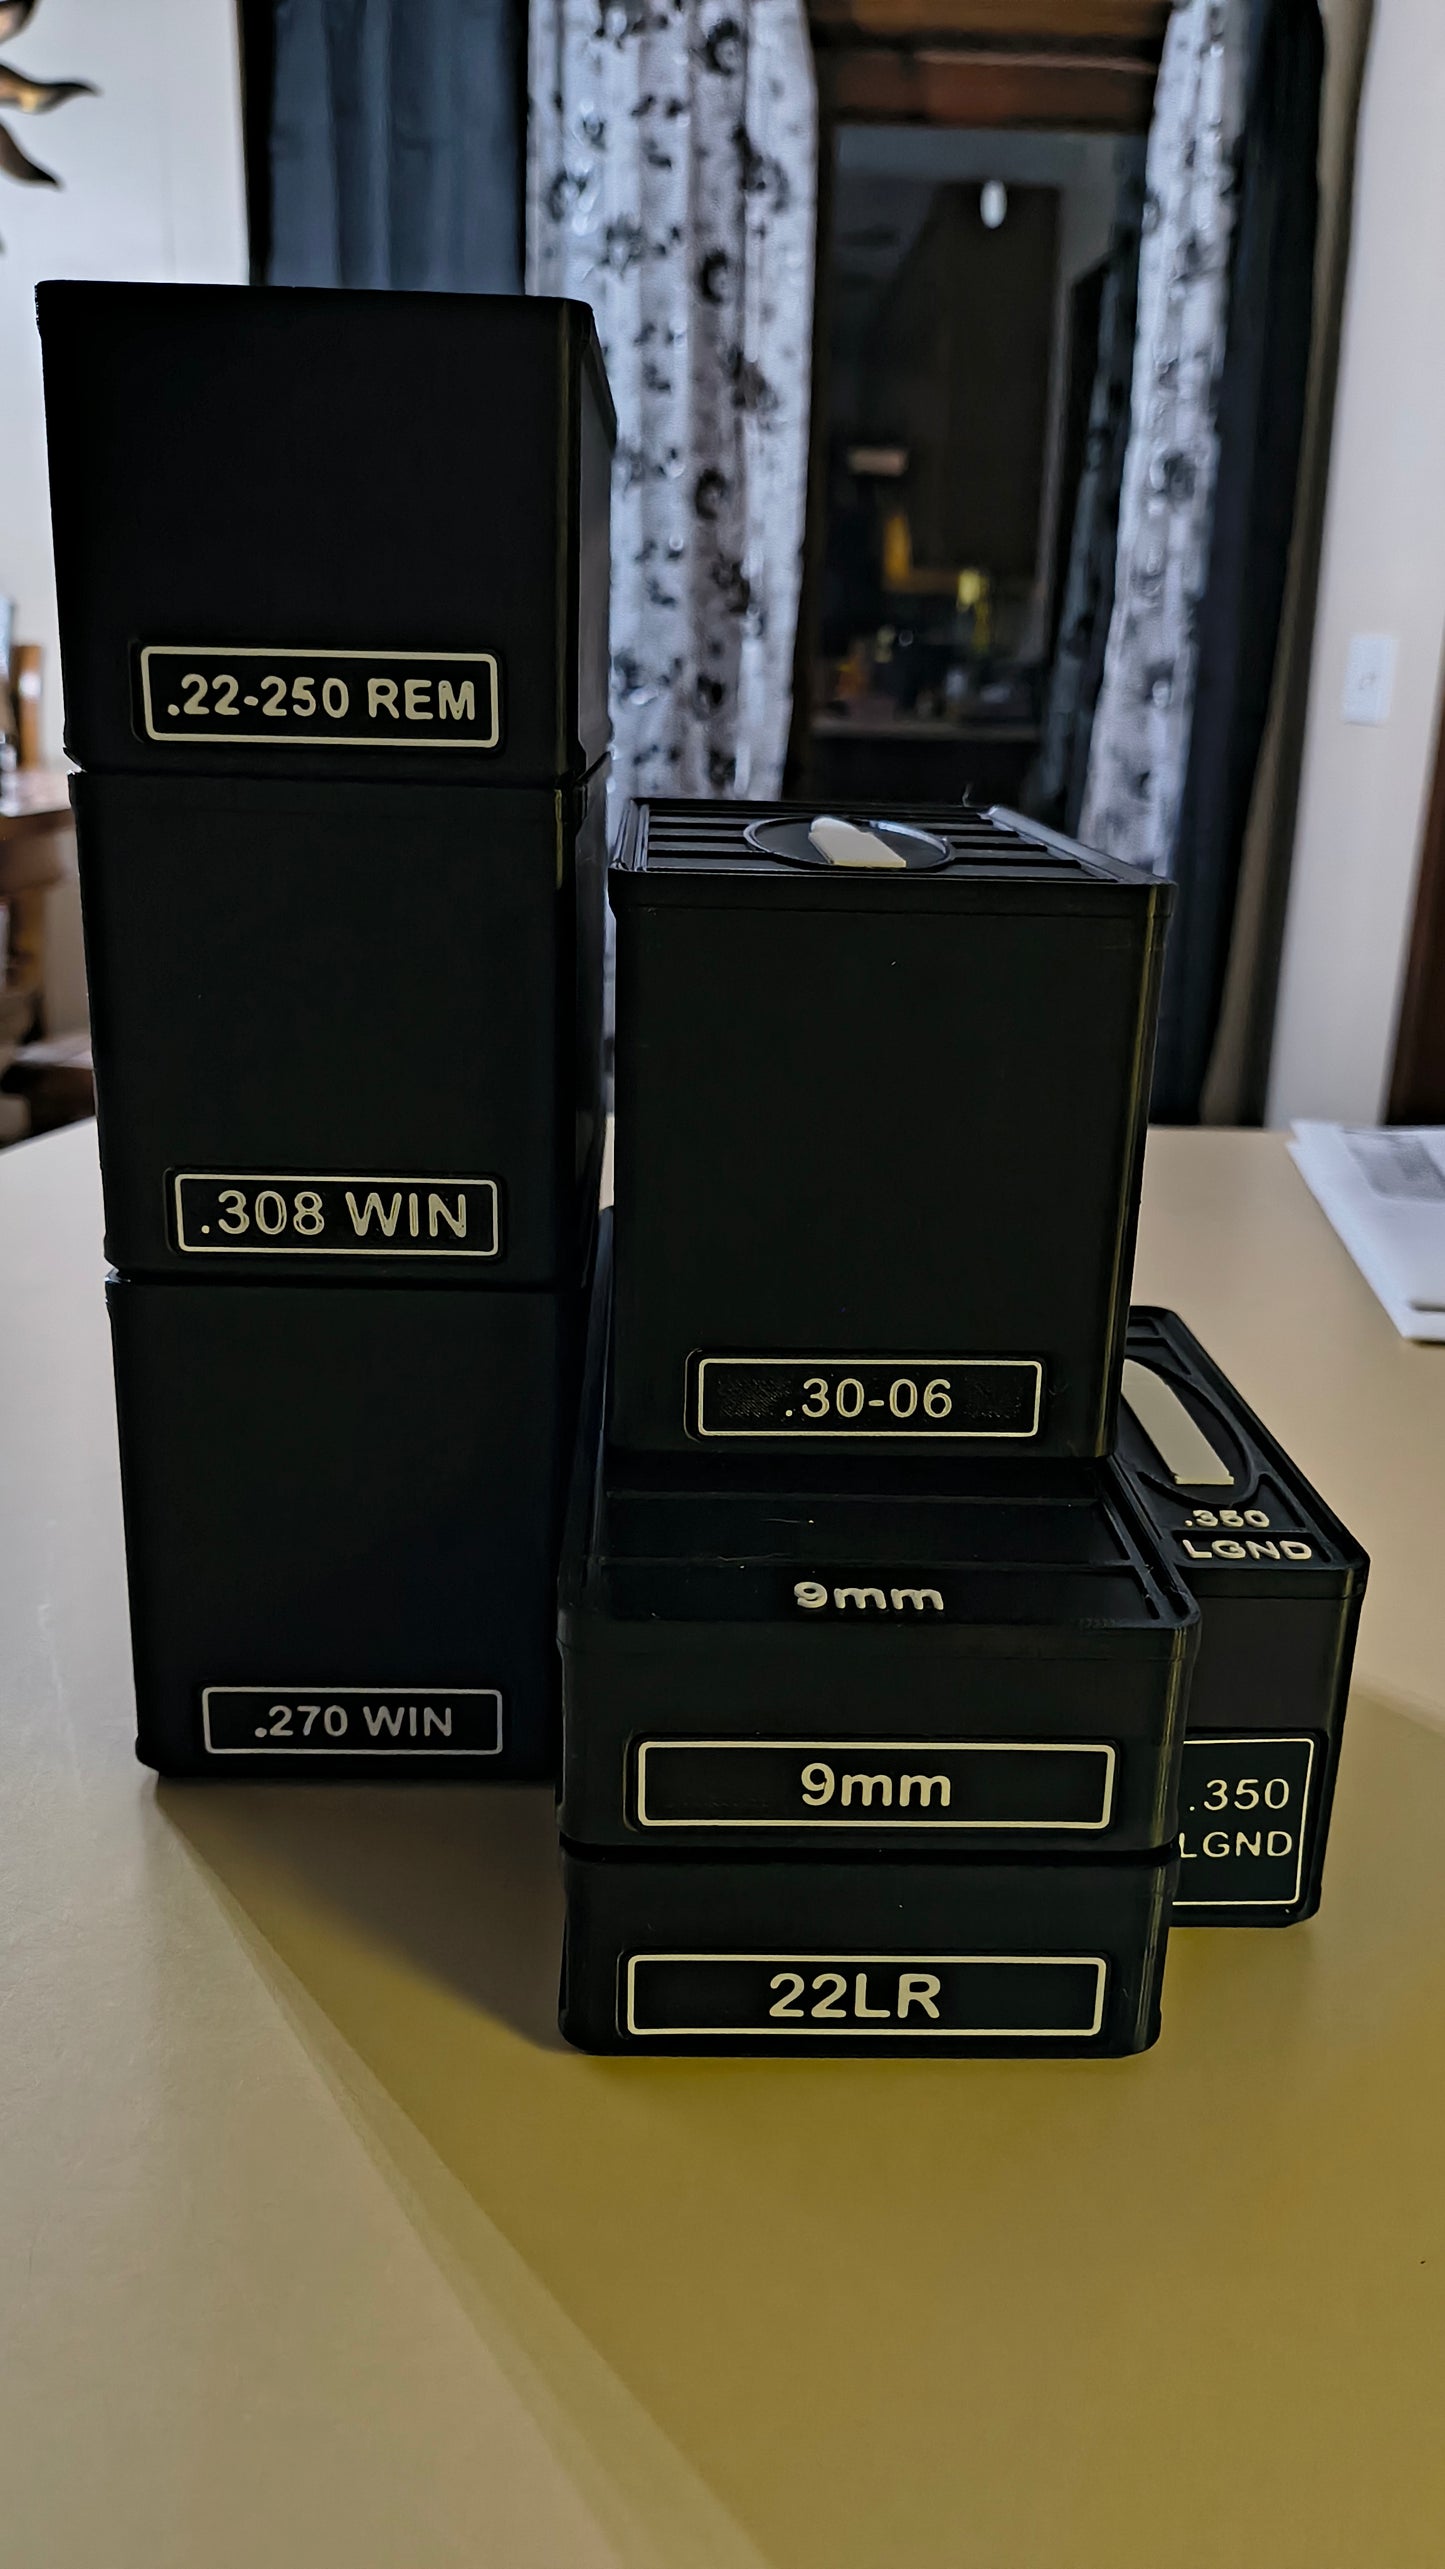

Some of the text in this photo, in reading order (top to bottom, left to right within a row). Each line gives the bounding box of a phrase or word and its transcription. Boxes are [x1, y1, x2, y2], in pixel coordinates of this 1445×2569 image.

[167, 673, 476, 721] .22-250 REM
[201, 1188, 468, 1238] .308 WIN
[785, 1377, 953, 1419] .30-06
[1183, 1508, 1271, 1529] .350
[1181, 1538, 1314, 1561] LGND
[793, 1580, 944, 1613] 9mm
[254, 1704, 453, 1738] .270 WIN
[800, 1761, 951, 1807] 9mm
[1188, 1777, 1290, 1812] .350
[1177, 1829, 1293, 1859] LGND
[767, 1971, 942, 2019] 22LR
